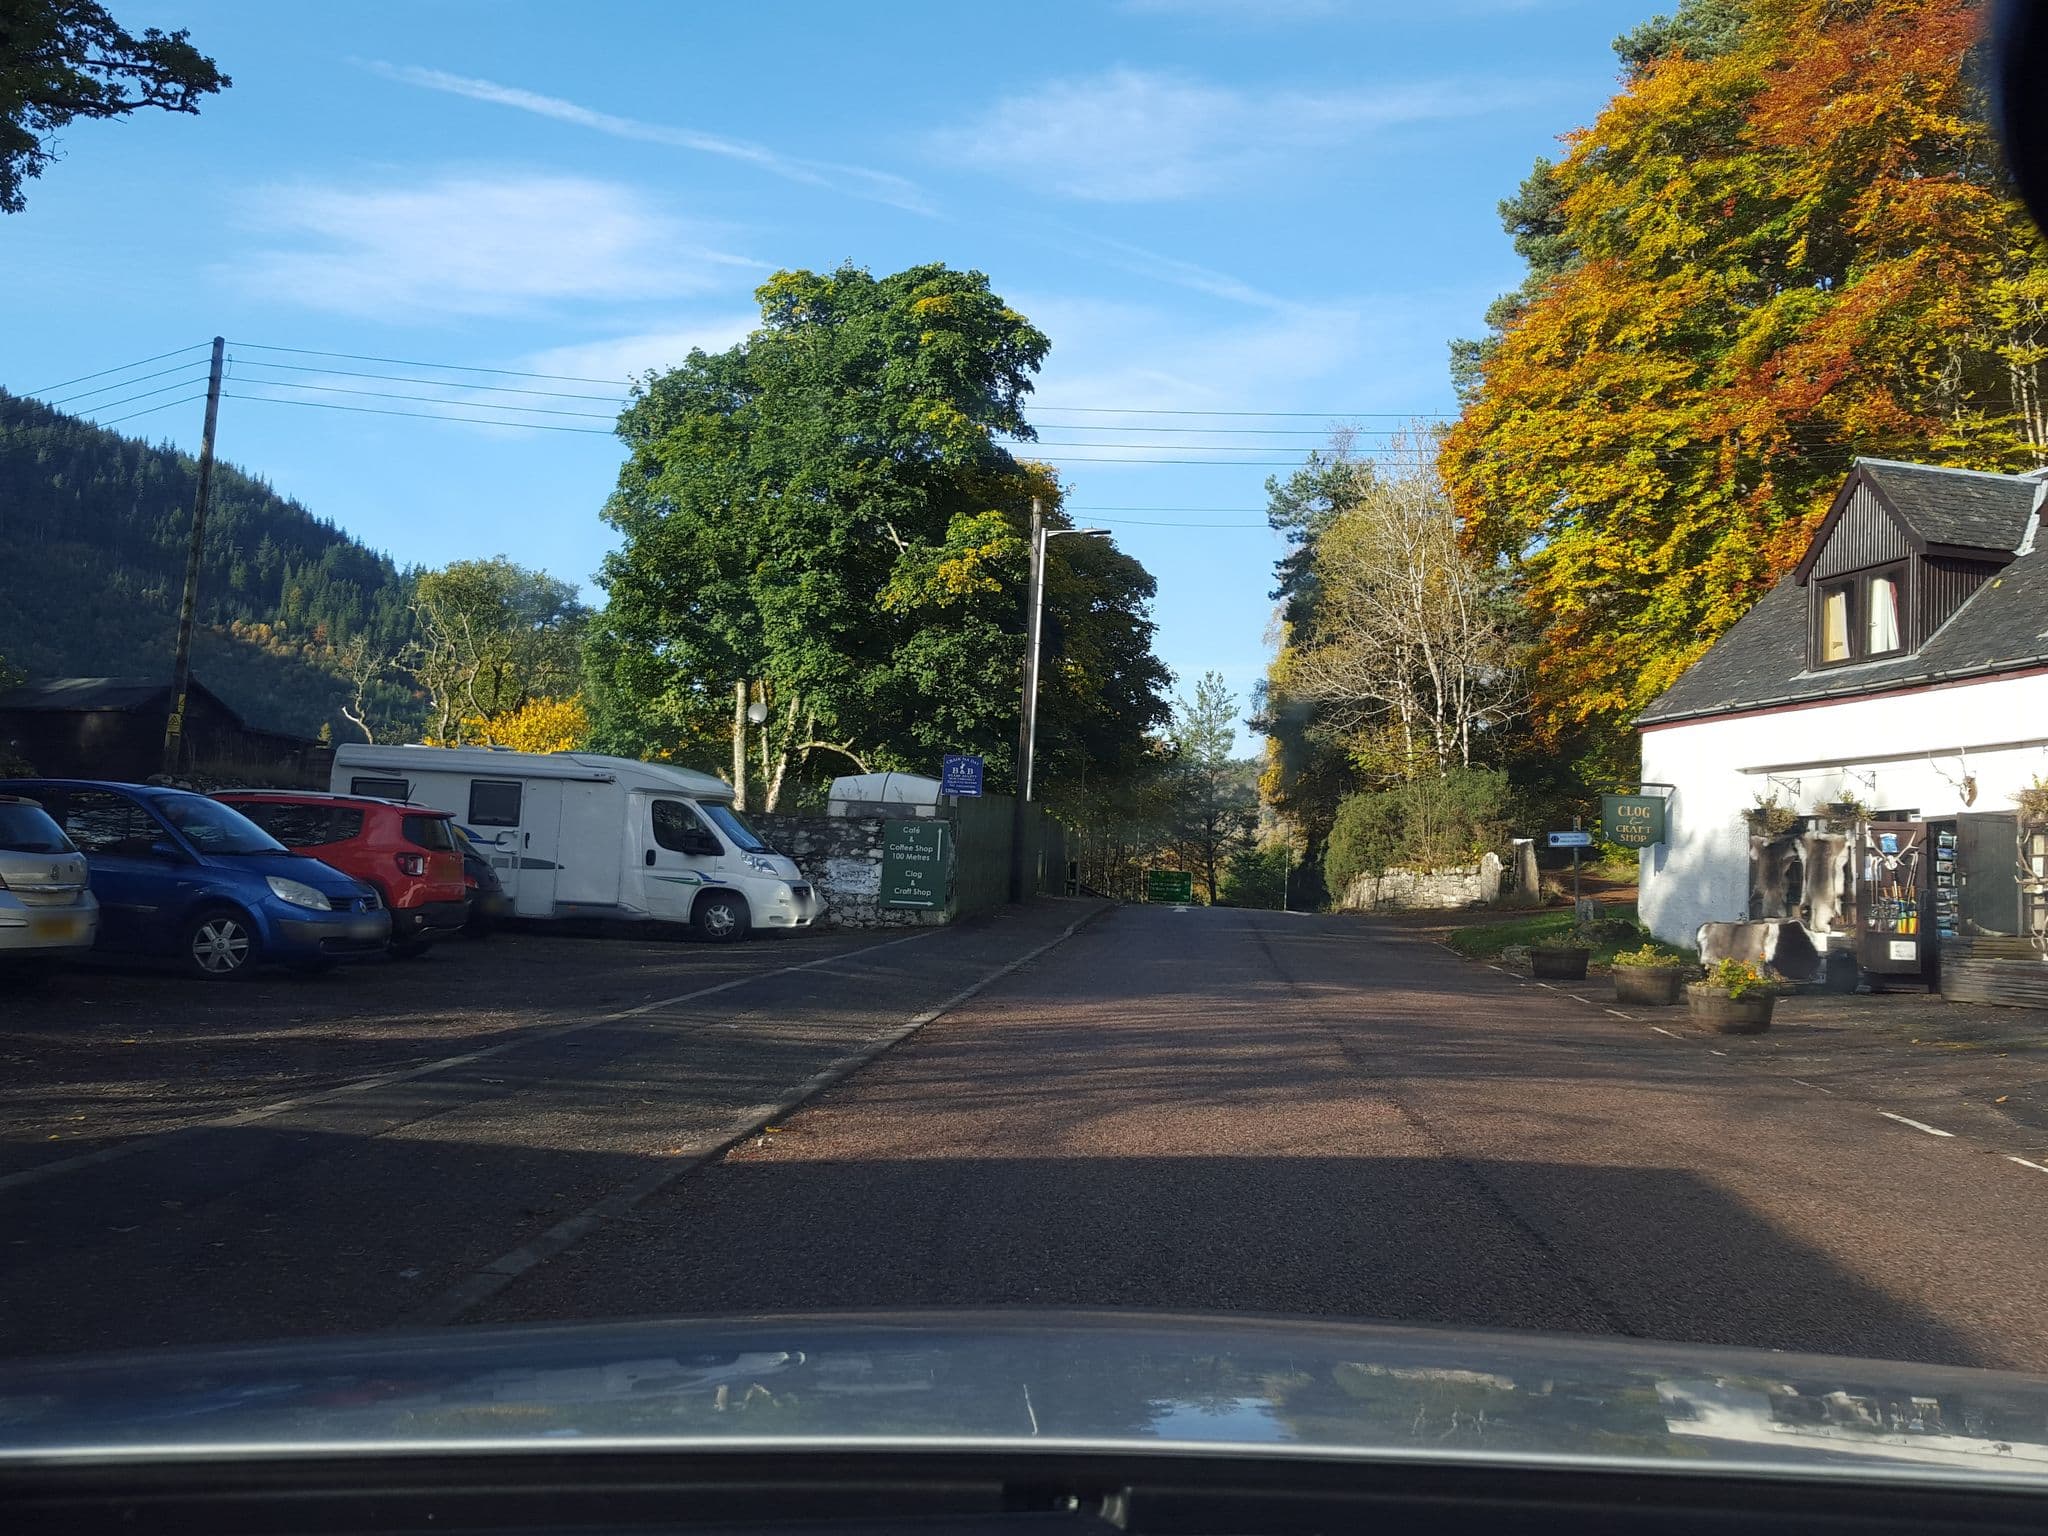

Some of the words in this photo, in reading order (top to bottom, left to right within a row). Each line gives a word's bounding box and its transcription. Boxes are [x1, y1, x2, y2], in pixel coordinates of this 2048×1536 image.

[1618, 805, 1650, 818] CLOG
[902, 826, 920, 834] Café
[1616, 824, 1653, 834] CRAFT
[1620, 834, 1647, 842] SHOP
[915, 844, 934, 853] Shop
[905, 870, 922, 878] Clog
[913, 888, 932, 896] Shop
